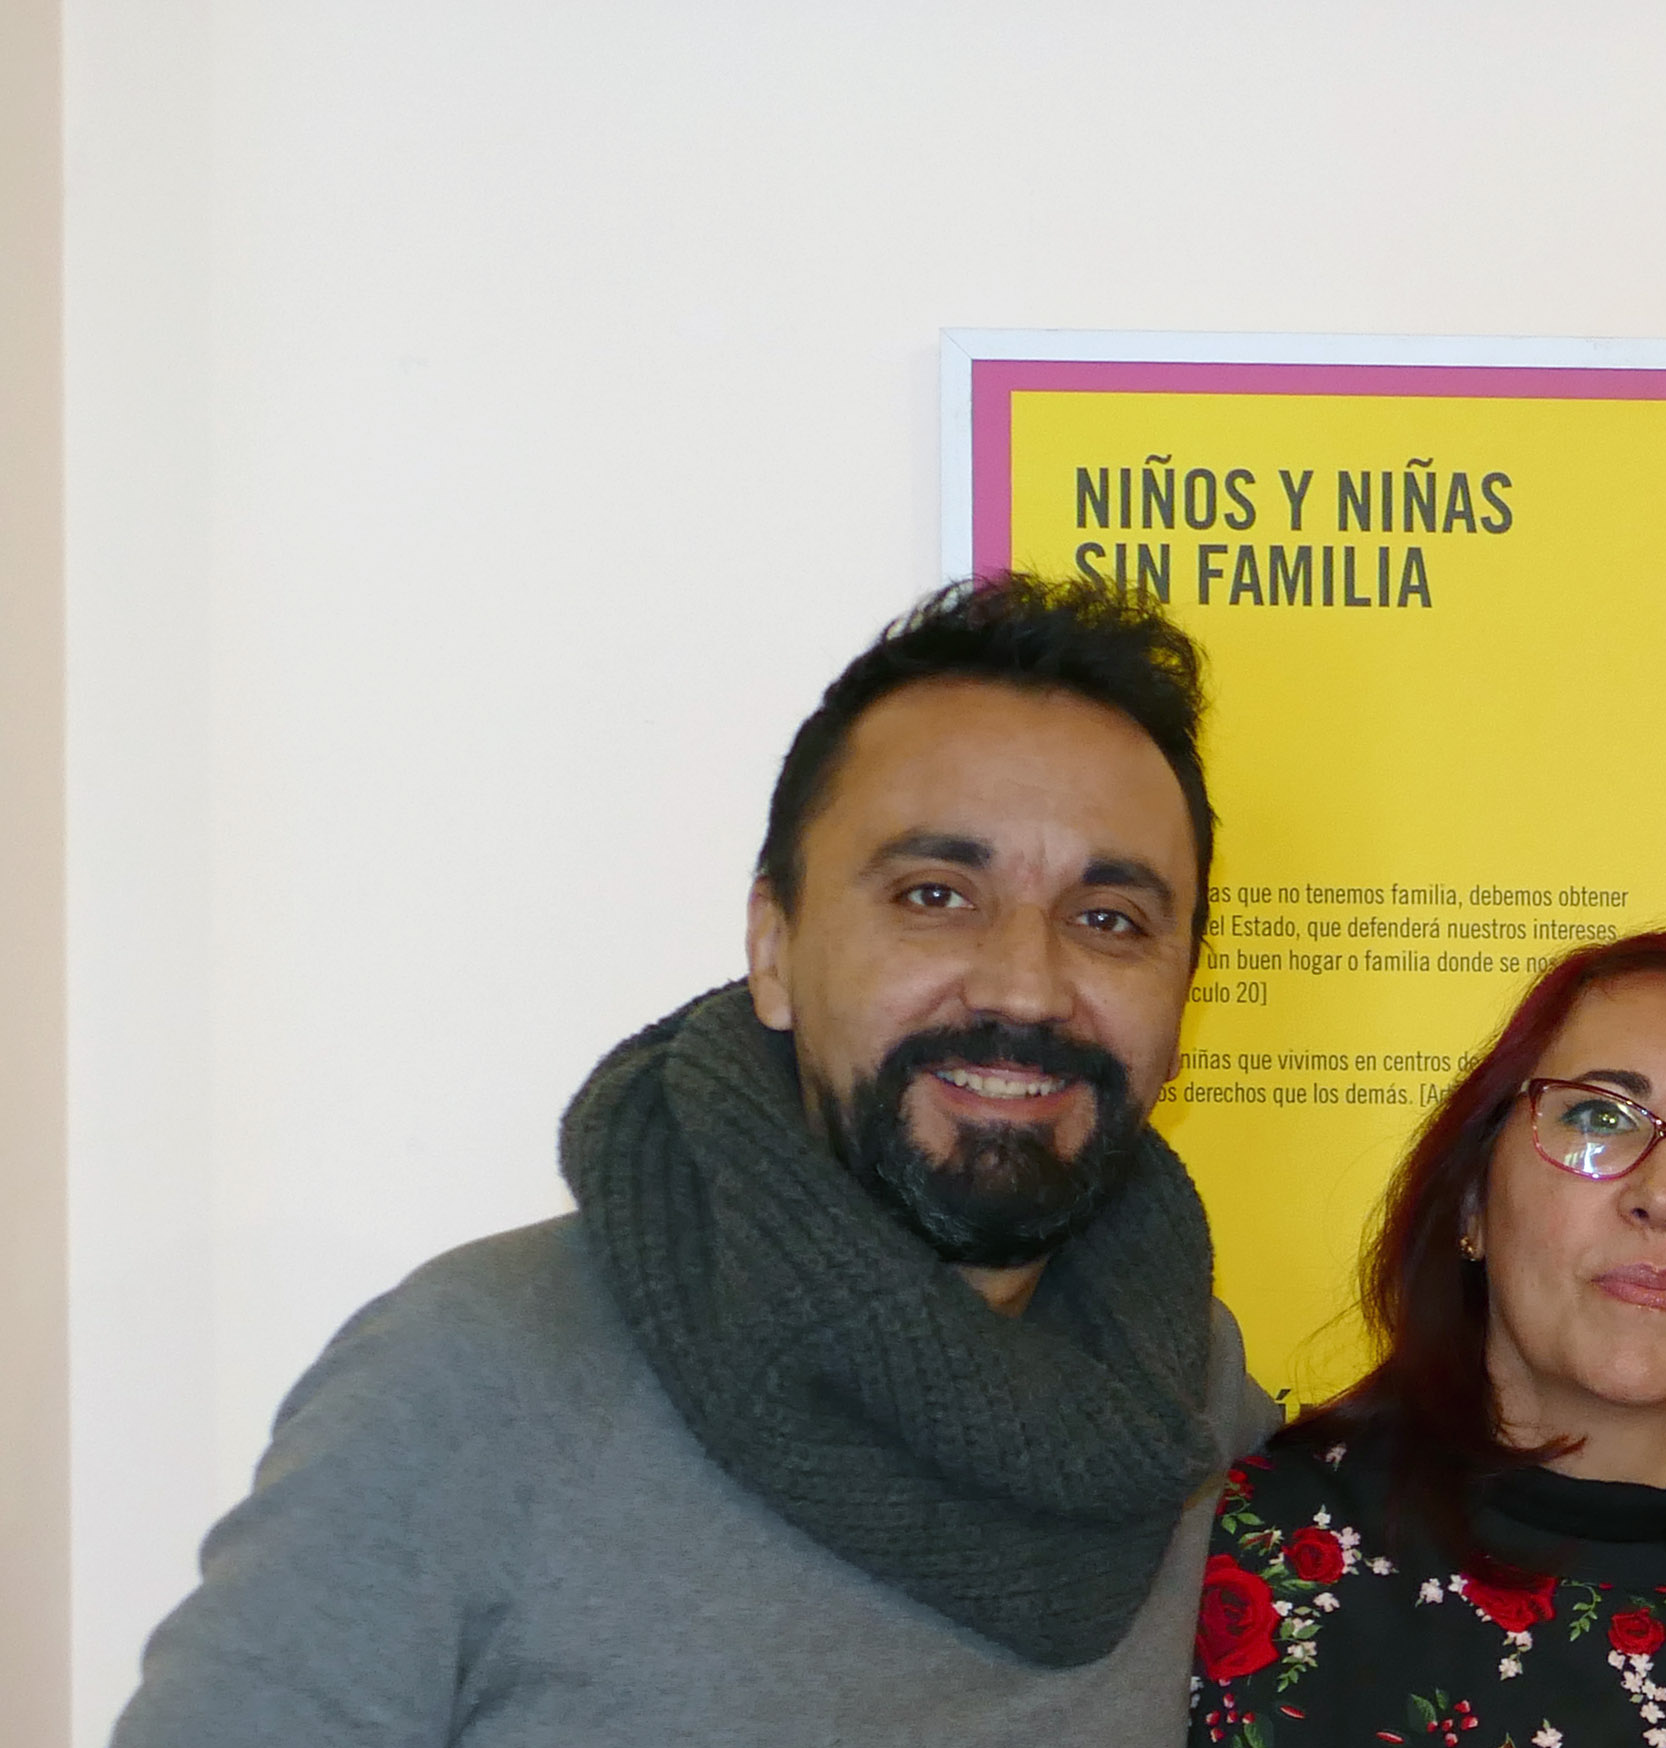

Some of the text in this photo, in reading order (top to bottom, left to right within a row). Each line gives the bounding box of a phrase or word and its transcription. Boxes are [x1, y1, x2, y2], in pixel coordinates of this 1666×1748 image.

[1077, 454, 1512, 534] NIÑOS Y NIÑAS
[1075, 542, 1432, 608] SIN FAMILIA
[1238, 888, 1272, 907] que
[1279, 888, 1300, 903] no
[1306, 883, 1384, 904] tenemos
[1391, 883, 1462, 909] familia,
[1470, 884, 1552, 906] debemos
[1559, 886, 1629, 907] obtener
[1232, 915, 1300, 940] Estado,
[1308, 921, 1341, 941] que
[1348, 916, 1439, 938] defenderá
[1448, 919, 1526, 939] nuestros
[1534, 918, 1618, 940] intereses
[1207, 953, 1229, 970] un
[1238, 949, 1281, 970] buen
[1289, 949, 1343, 975] hogar
[1348, 955, 1358, 971] o
[1364, 950, 1429, 971] familia
[1437, 951, 1493, 972] donde
[1500, 957, 1519, 973] se
[1237, 982, 1267, 1006] 20]
[1238, 1054, 1272, 1074] que
[1278, 1050, 1349, 1071] vivimos
[1355, 1055, 1376, 1071] en
[1383, 1051, 1451, 1072] centros
[1184, 1081, 1266, 1103] derechos
[1273, 1087, 1307, 1108] que
[1314, 1083, 1339, 1104] los
[1346, 1083, 1413, 1104] demás.
